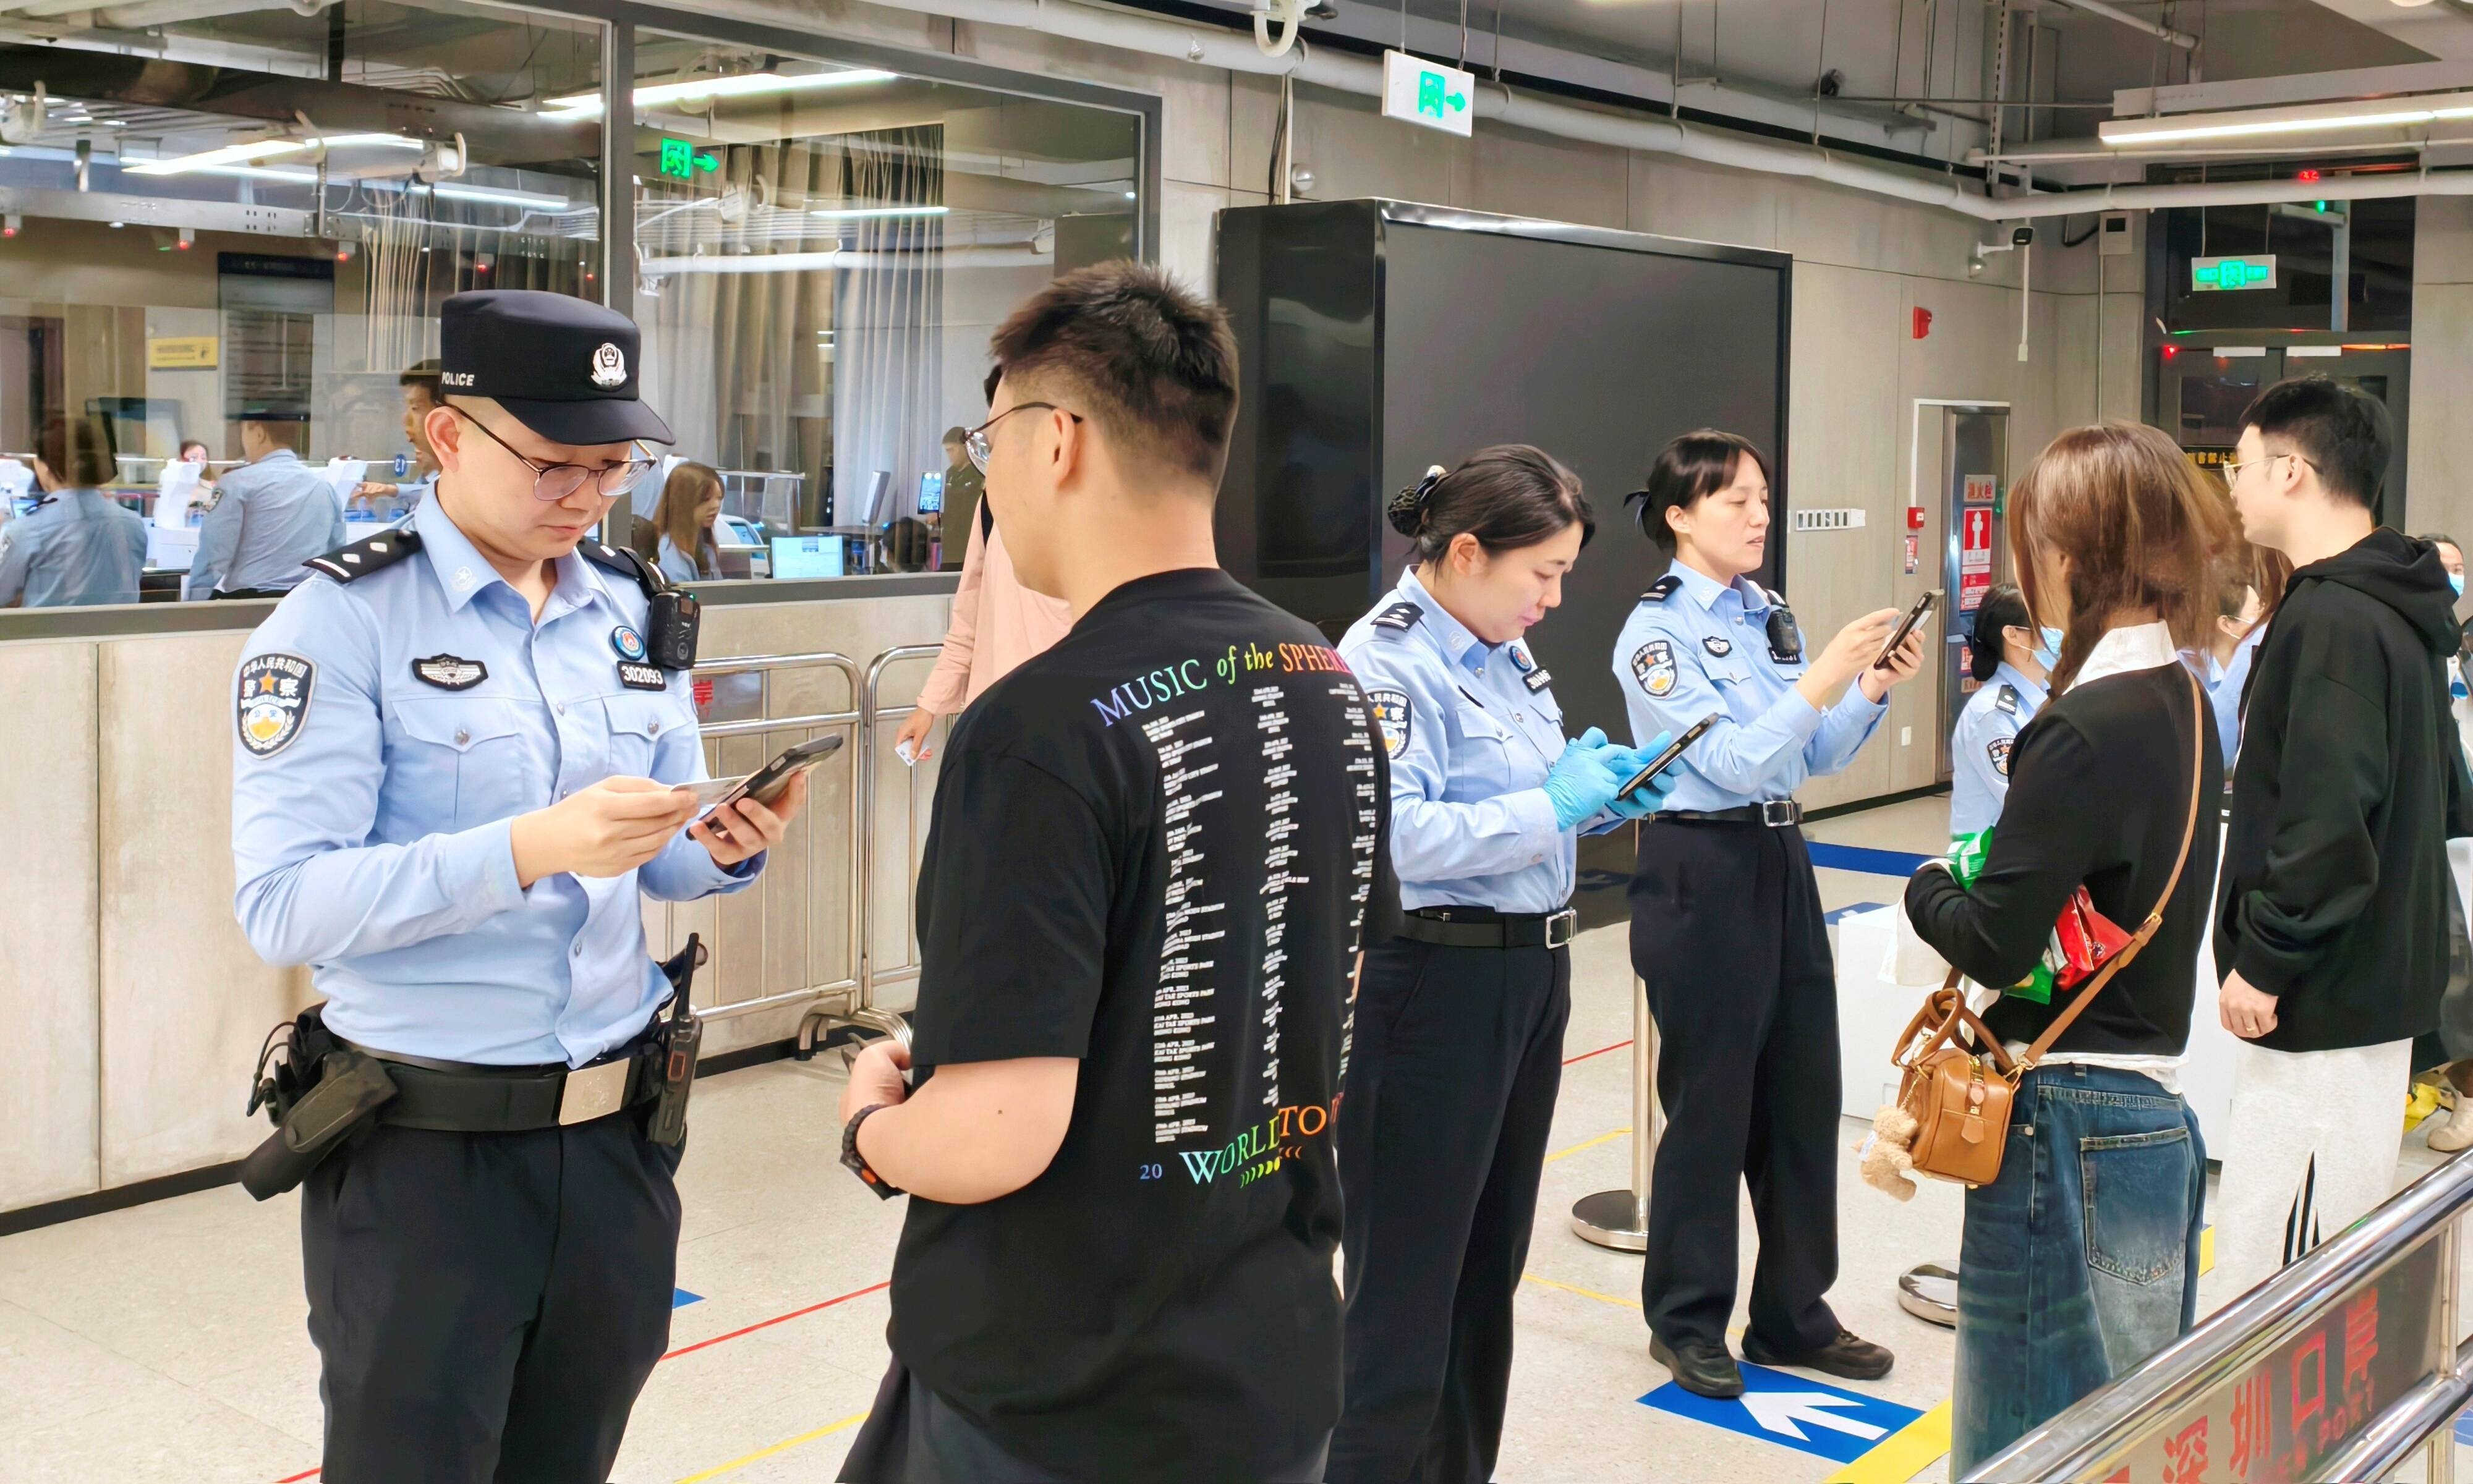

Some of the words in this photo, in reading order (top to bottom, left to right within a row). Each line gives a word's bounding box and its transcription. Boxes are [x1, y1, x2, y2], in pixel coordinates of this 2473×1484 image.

[441, 371, 475, 386] POLICE
[243, 656, 308, 679] 中华人民共和国
[621, 666, 664, 685] 302093
[1090, 659, 1207, 727] MUSIC
[1217, 645, 1236, 685] of
[1244, 643, 1274, 671] the
[1140, 1164, 1162, 1180] 20
[1178, 1115, 1280, 1185] WORLD
[2102, 1286, 2379, 1483] 深圳口岸
